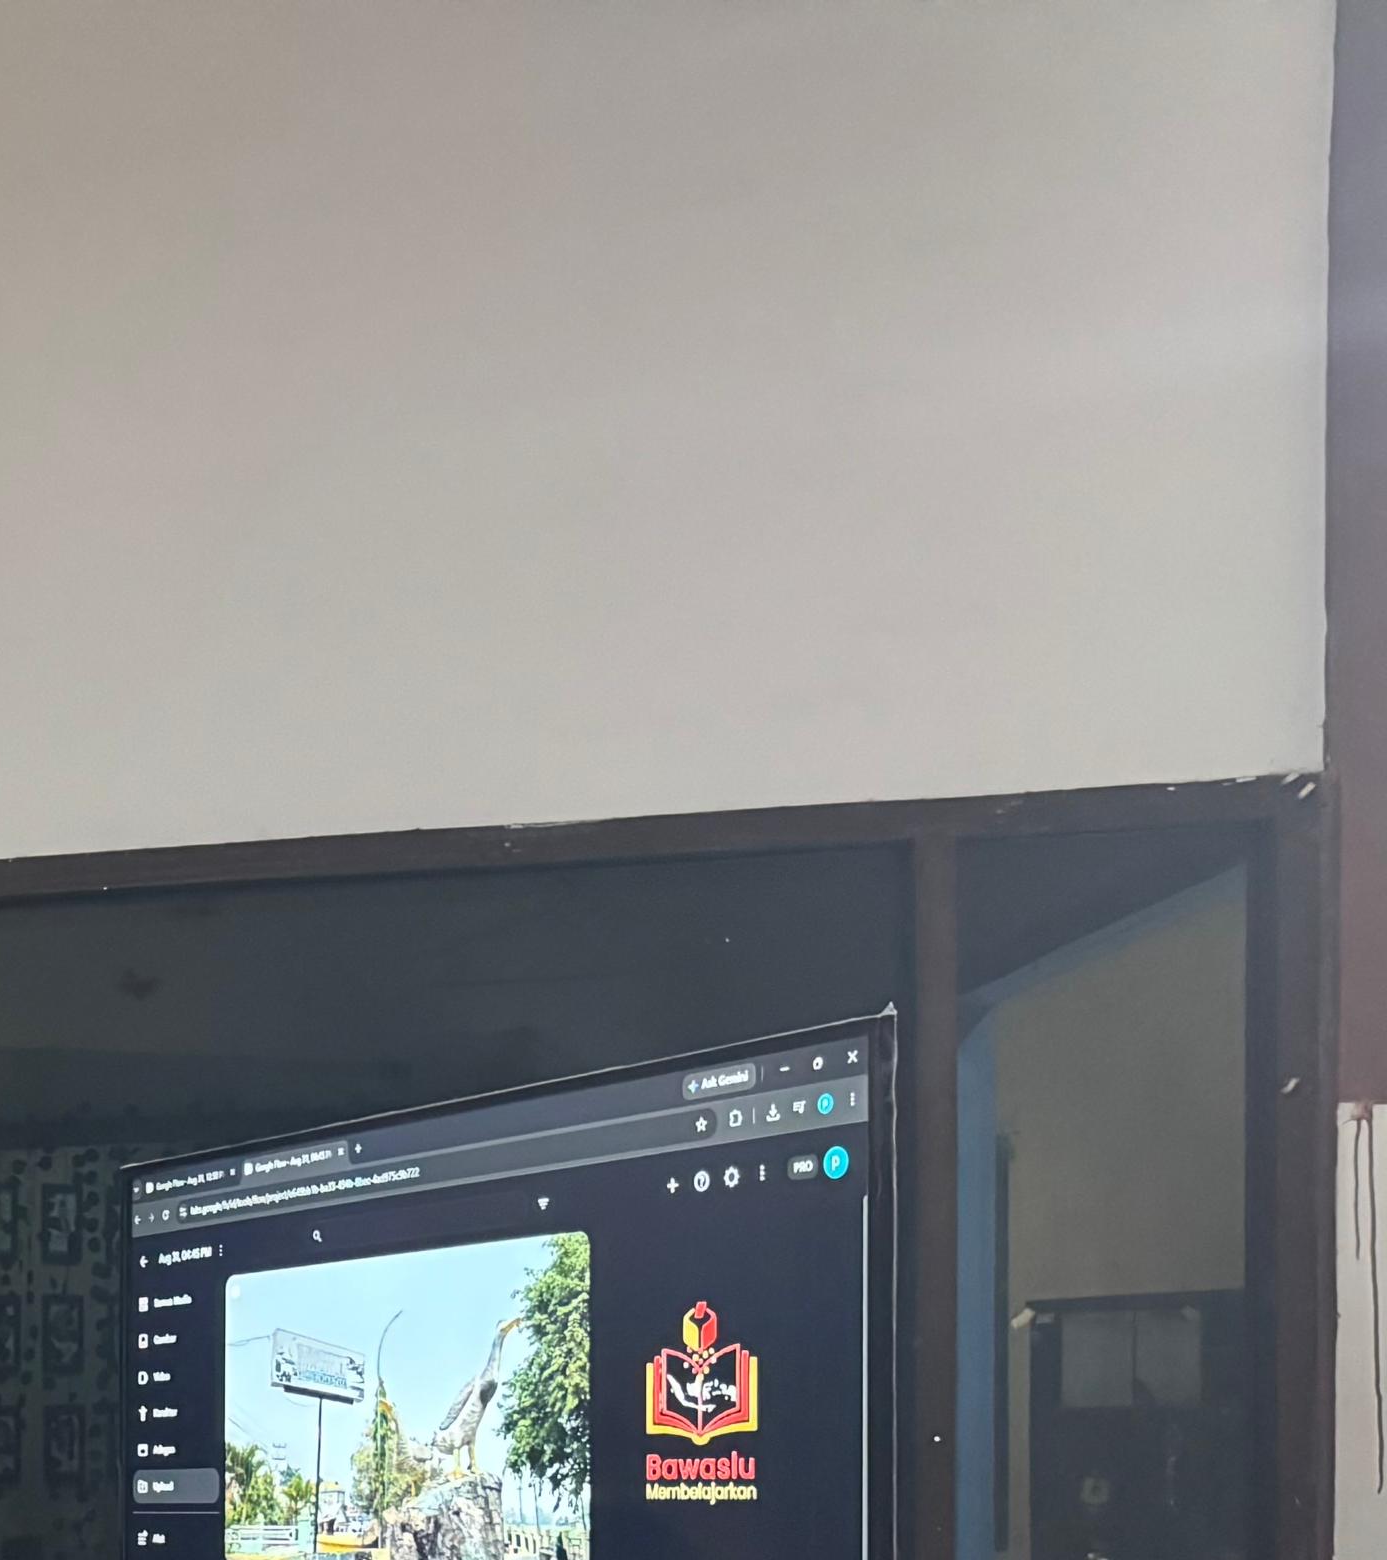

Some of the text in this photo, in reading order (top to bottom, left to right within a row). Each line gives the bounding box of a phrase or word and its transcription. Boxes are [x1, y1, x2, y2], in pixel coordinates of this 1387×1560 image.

[701, 1069, 749, 1090] Ask Gemini
[793, 1159, 814, 1174] PRO
[646, 1450, 756, 1480] Bawaslu
[645, 1481, 758, 1506] Membelajarkan
